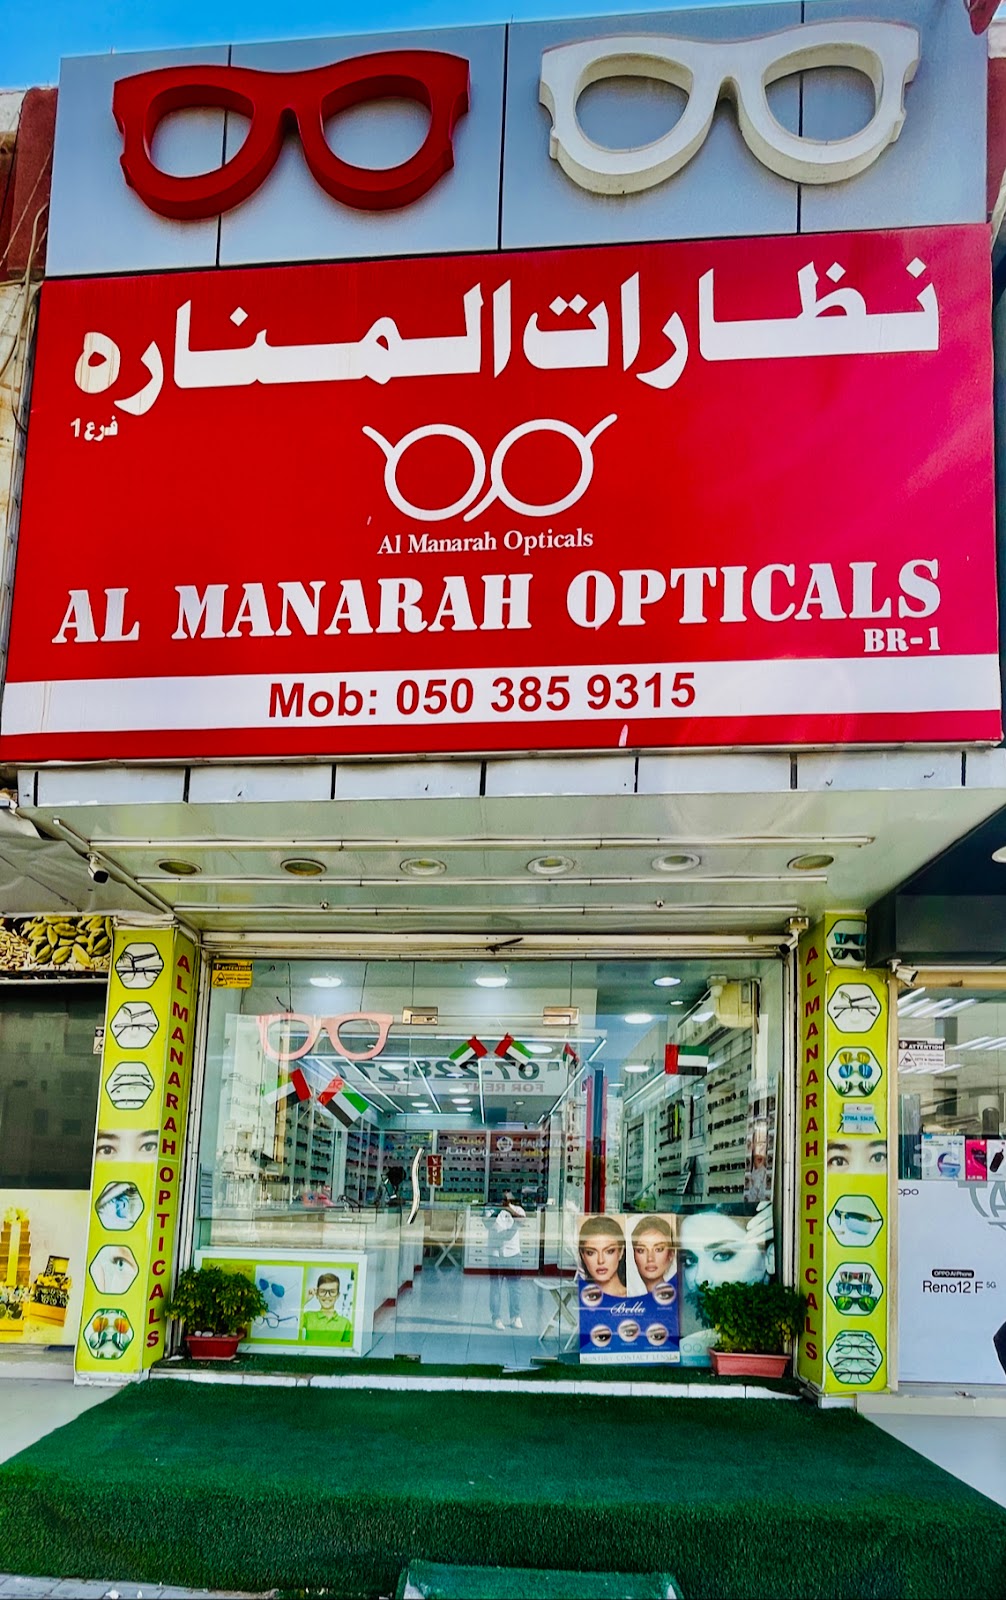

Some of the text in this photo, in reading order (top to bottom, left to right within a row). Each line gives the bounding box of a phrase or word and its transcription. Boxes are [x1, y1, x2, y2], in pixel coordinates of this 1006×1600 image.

[75, 257, 940, 416] نظارات المناره
[84, 415, 118, 441] فرع
[378, 528, 594, 556] Al Manarah Opticals
[52, 558, 941, 644] AL MANARAH OPTICALS
[864, 627, 940, 652] BR-1
[269, 671, 696, 718] Mob: 050 385 9315
[145, 954, 191, 1349] AL MANARAH OPTICALS
[804, 946, 820, 1361] AL MANARAH OPTICALS
[922, 1280, 997, 1294] Reno12 F 5G
[610, 1301, 646, 1314] Bella
